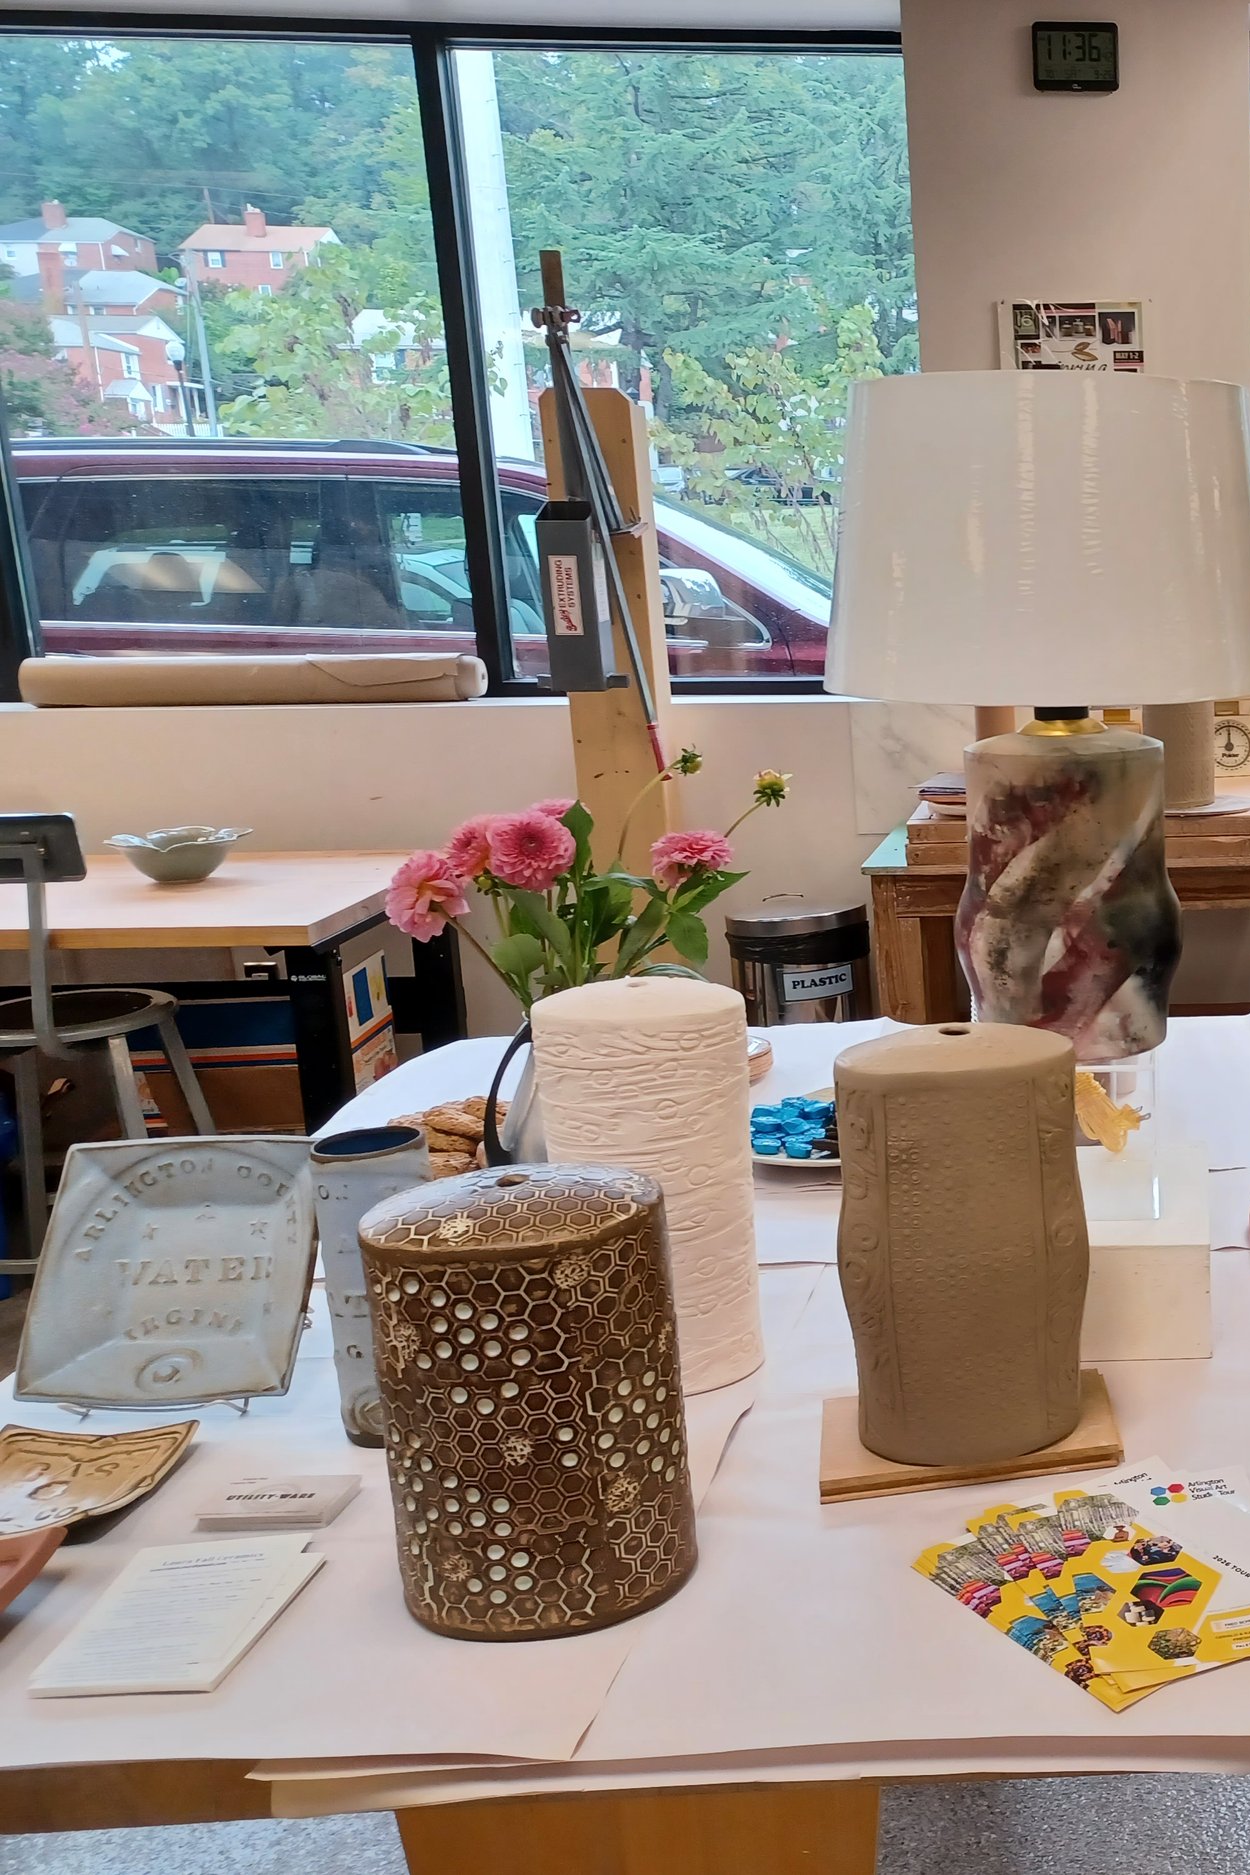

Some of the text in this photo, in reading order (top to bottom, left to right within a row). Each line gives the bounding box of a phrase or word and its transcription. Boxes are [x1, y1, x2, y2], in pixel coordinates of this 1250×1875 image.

[1048, 33, 1101, 62] 11:36
[554, 560, 567, 608] EXTRUDING
[564, 567, 576, 608] SYSTEMS
[792, 973, 847, 990] PLASTIC
[1188, 1478, 1224, 1488] Arlington
[226, 1492, 316, 1501] UTILITY-WARE
